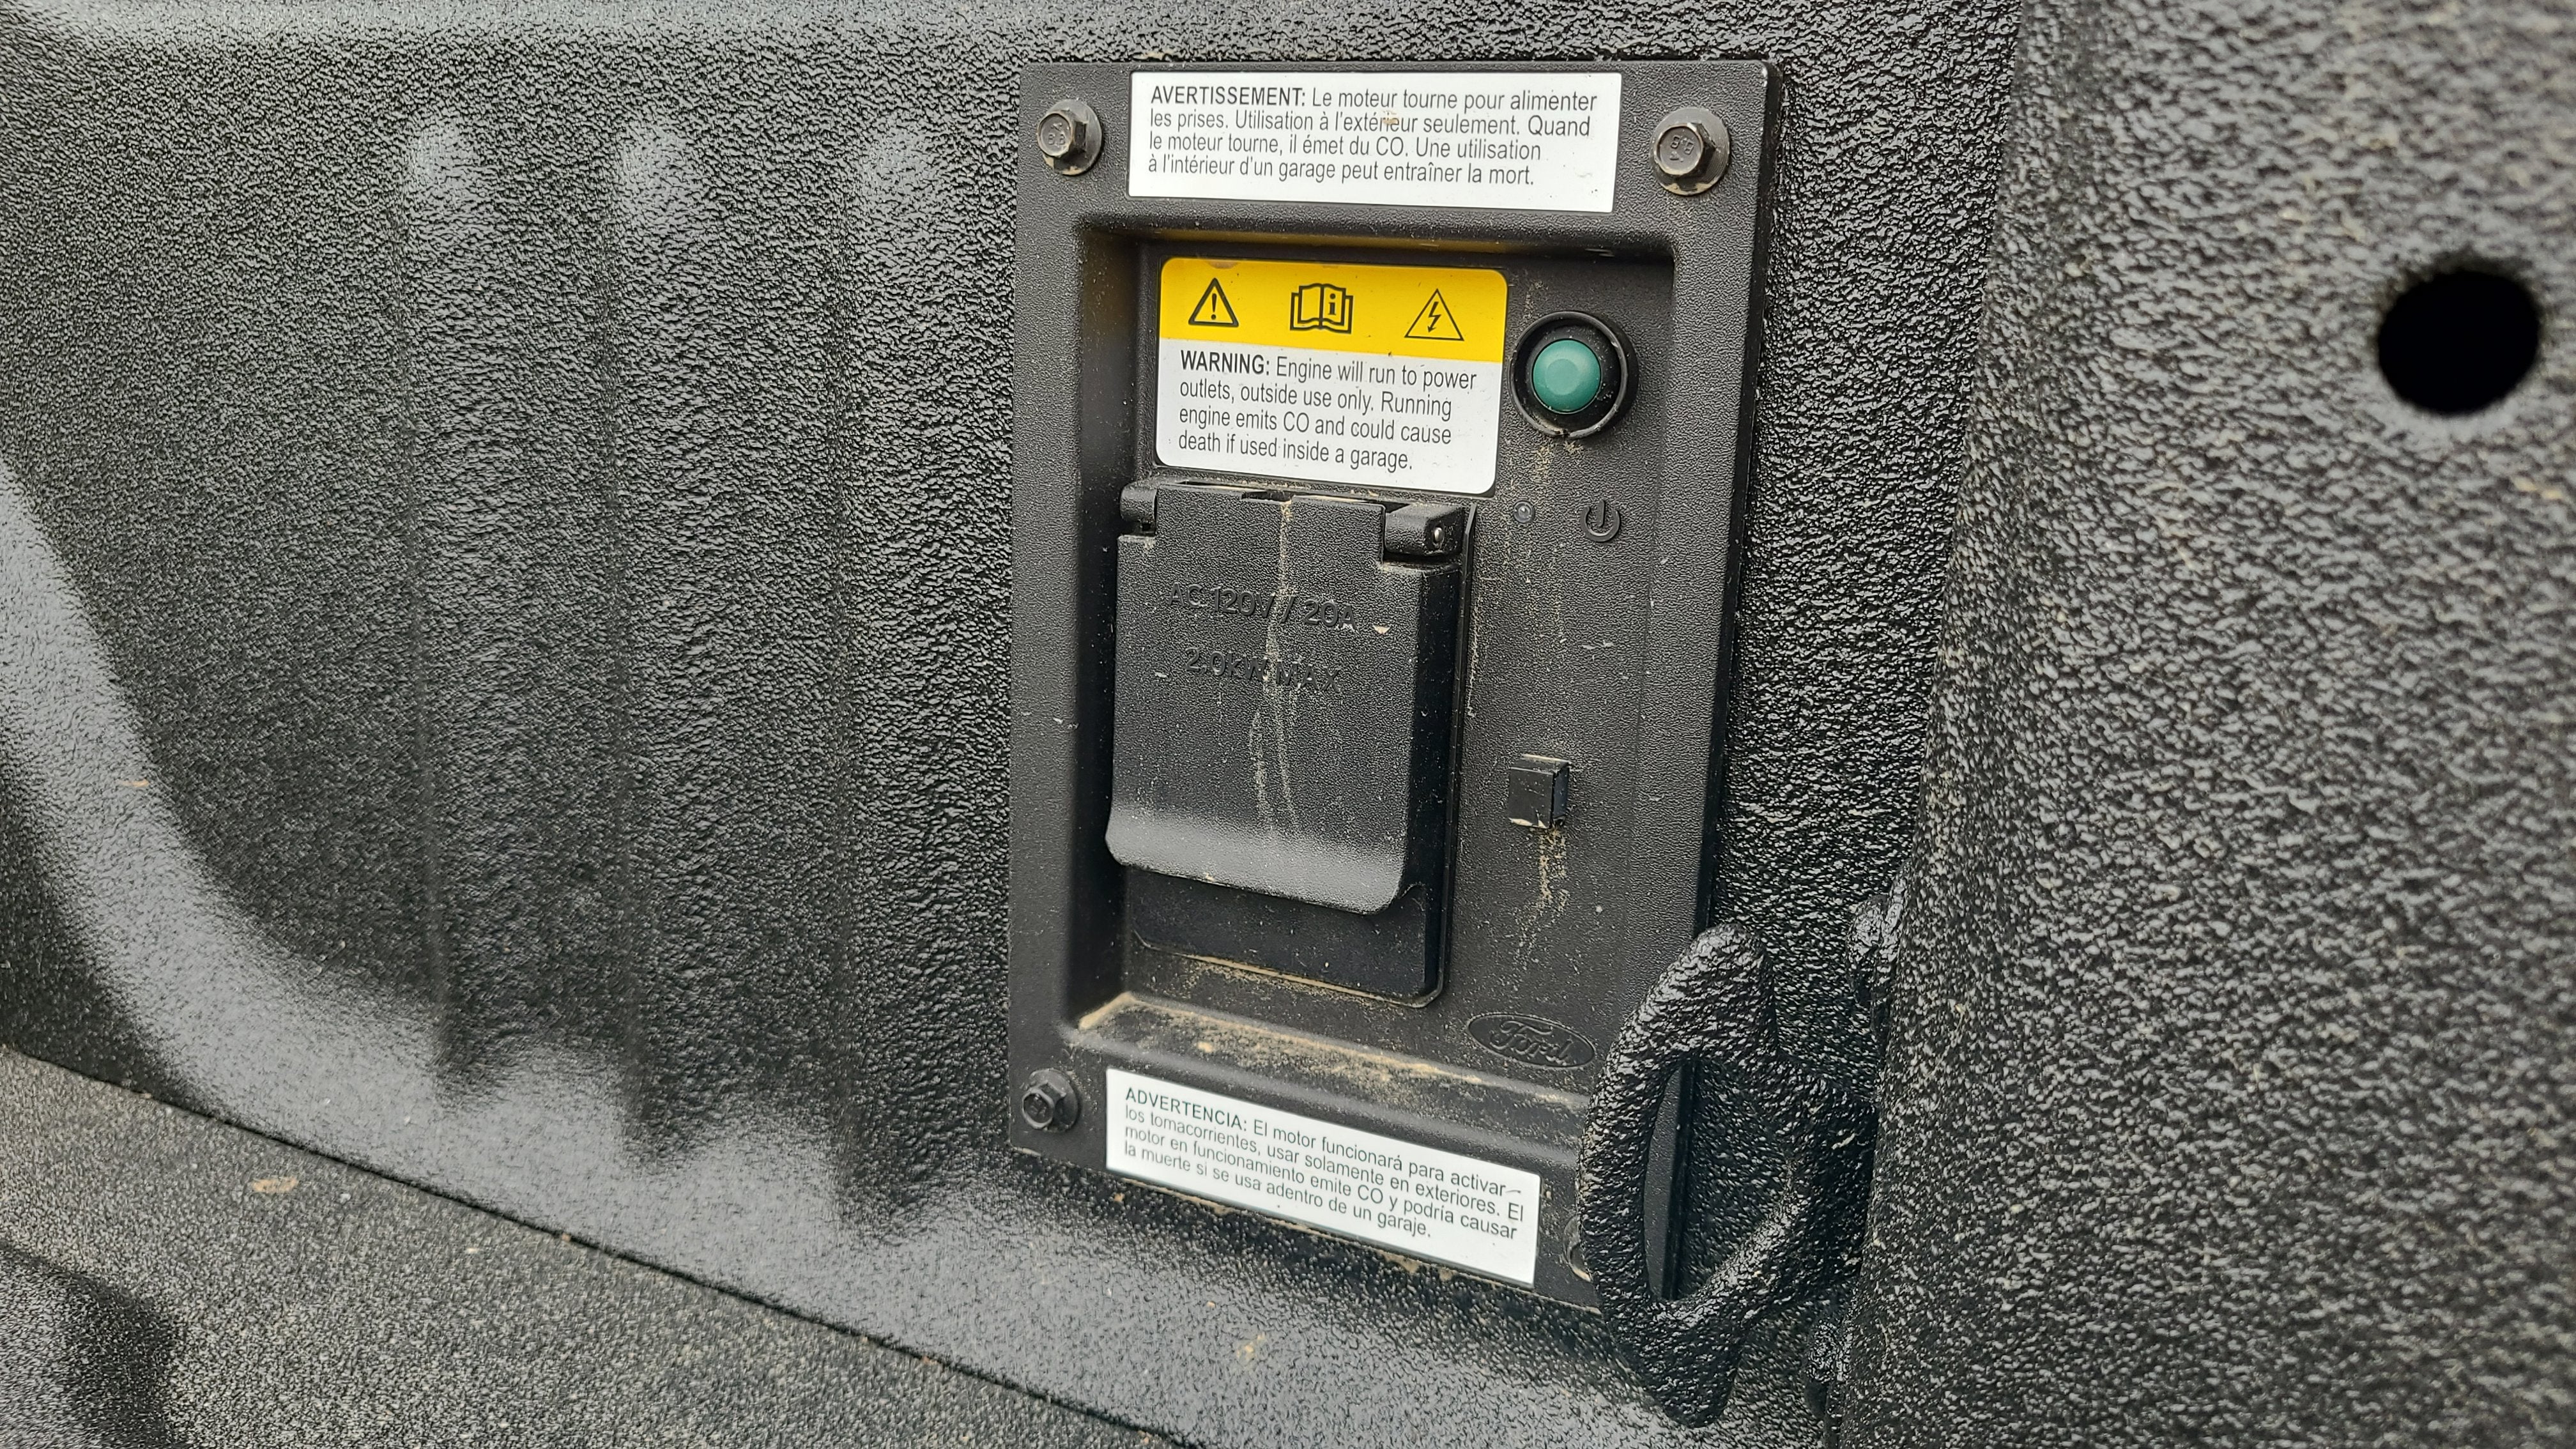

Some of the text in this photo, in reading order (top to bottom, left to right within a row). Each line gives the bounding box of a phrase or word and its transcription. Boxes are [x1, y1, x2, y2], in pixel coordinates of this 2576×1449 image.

[1151, 86, 1597, 114] AVERTISSEMENT: Le moteur tourne pour alimenter
[1151, 108, 1590, 137] les prises. Utilisation à l'extérieur seulement. Quand
[1150, 130, 1540, 160] le moteur tourne, il émet du CO. Une utilisation
[1149, 153, 1533, 185] à l'intérieur d'un garage peut entraîner la mort.
[1181, 349, 1477, 392] WARNING: Engine will run to power
[1180, 378, 1452, 422] outlets, outside use only. Running
[1179, 405, 1451, 445] engine emits CO and could cause
[1179, 429, 1412, 473] death if used inside a garage.
[1168, 583, 1205, 608] AC
[1211, 586, 1276, 618] 120V
[1302, 599, 1358, 629] 20A
[1276, 658, 1341, 693] MAX
[1489, 1020, 1574, 1066] Ford
[1126, 1087, 1506, 1197] ADVERTENCIA: El motor funcionará para activar
[1126, 1105, 1523, 1222] los tomacorrientes, usar solamente en exteriores. El
[1125, 1141, 1430, 1237] la muerte si se usa adentro de un garaje.
[1126, 1127, 1517, 1239] motor en funcionamiento emite CO y podría causar
